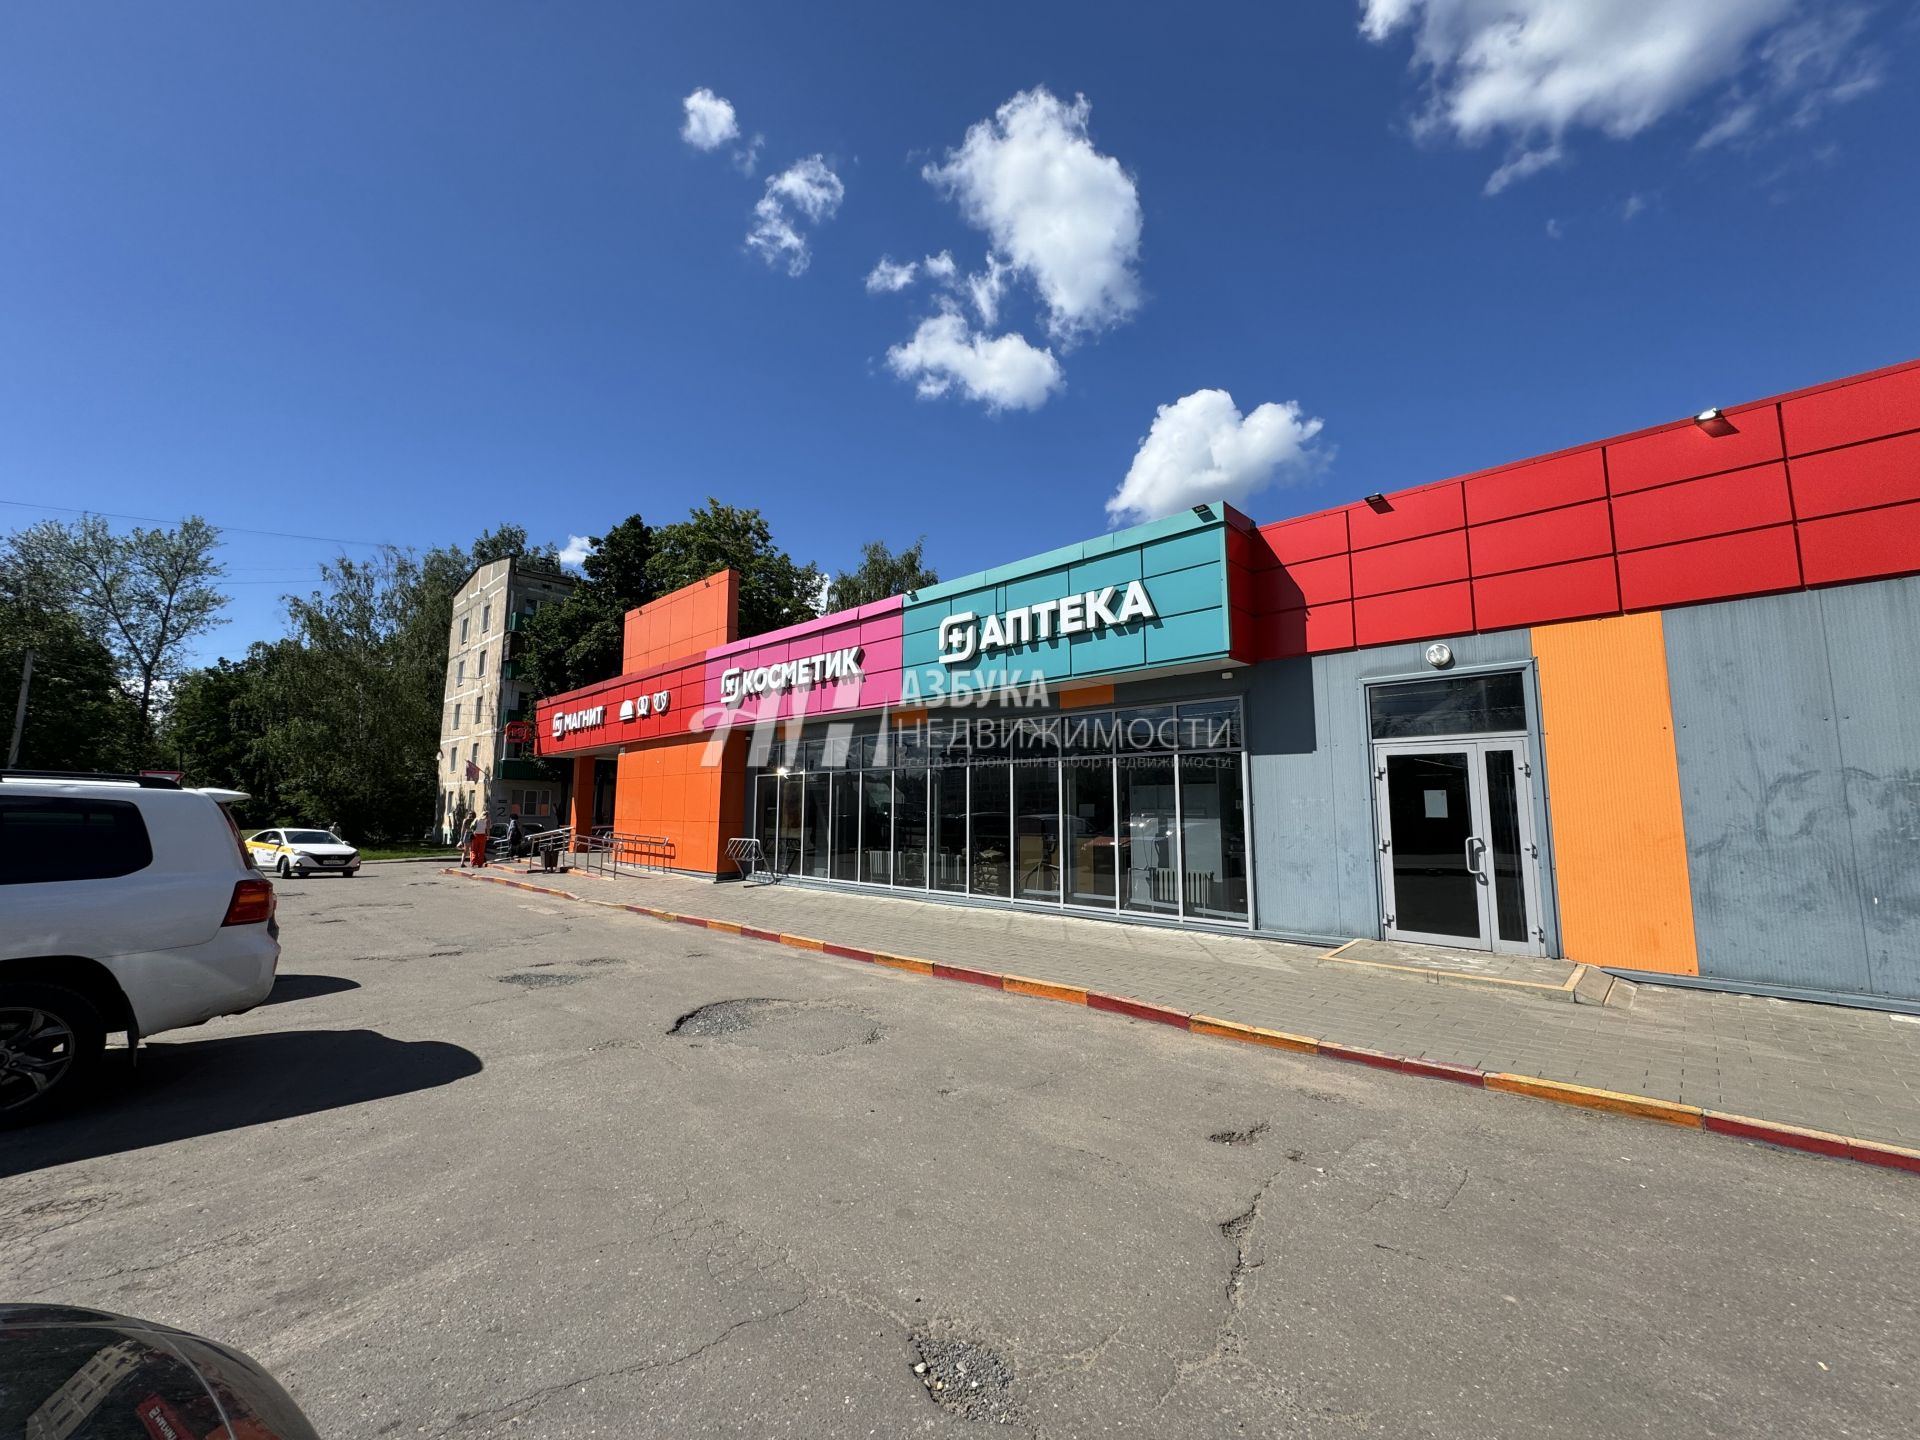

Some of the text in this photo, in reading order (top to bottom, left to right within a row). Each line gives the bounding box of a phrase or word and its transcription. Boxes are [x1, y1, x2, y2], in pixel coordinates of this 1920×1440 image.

[979, 580, 1156, 650] АПТЕКА
[742, 646, 864, 695] КОСМЕТИК
[564, 704, 605, 731] МАГНИТ
